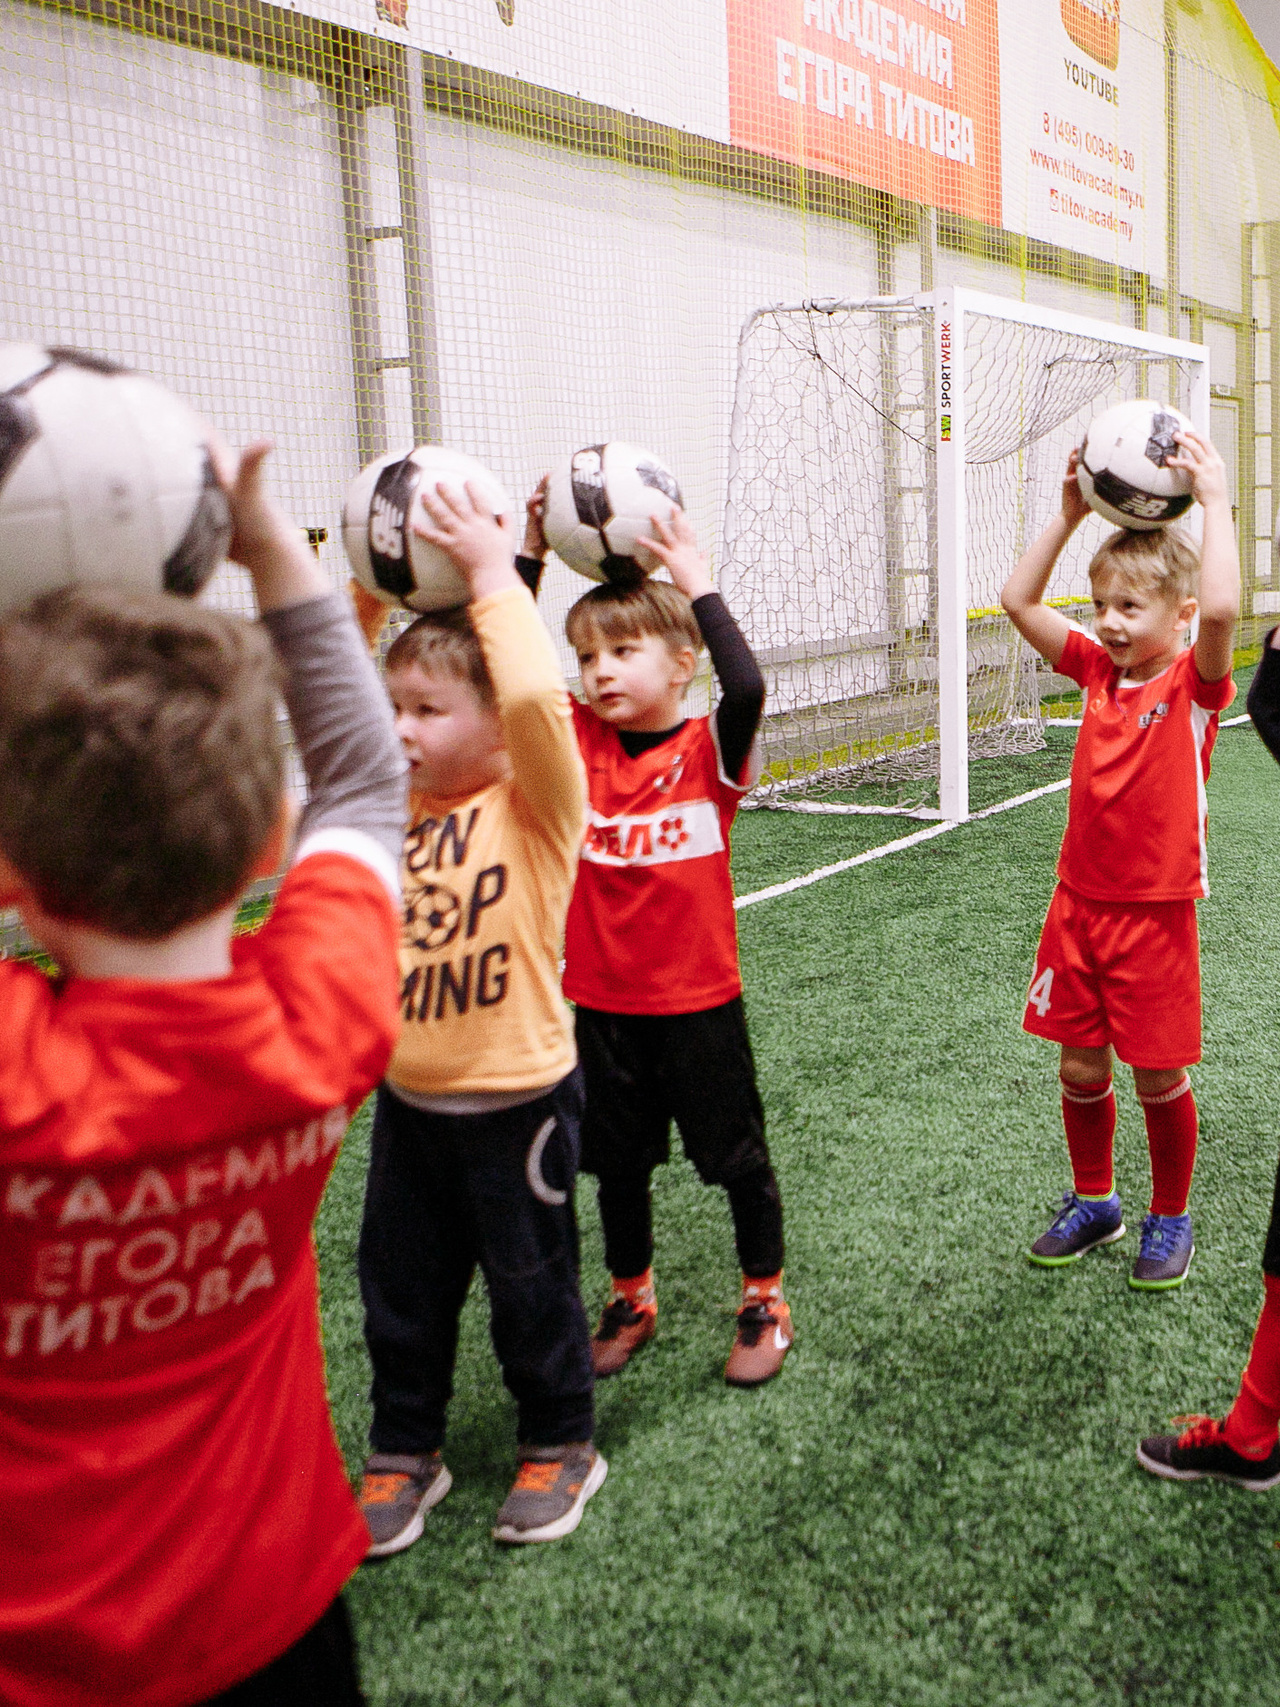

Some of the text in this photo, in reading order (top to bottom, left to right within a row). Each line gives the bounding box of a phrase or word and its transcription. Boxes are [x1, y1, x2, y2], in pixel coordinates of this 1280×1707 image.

[776, 36, 976, 167] ЕГОРА ТИТОВА
[1064, 57, 1119, 107] YOUTUBE
[1043, 112, 1050, 135] 8
[1054, 115, 1082, 154] (495)
[1030, 148, 1145, 210] www.titovacademy.ru
[1061, 193, 1134, 242] titov.academy
[941, 322, 951, 408] SPORTWERK
[35, 1208, 268, 1296] ЕГОРА
[3, 1254, 275, 1356] ТИТОВА
